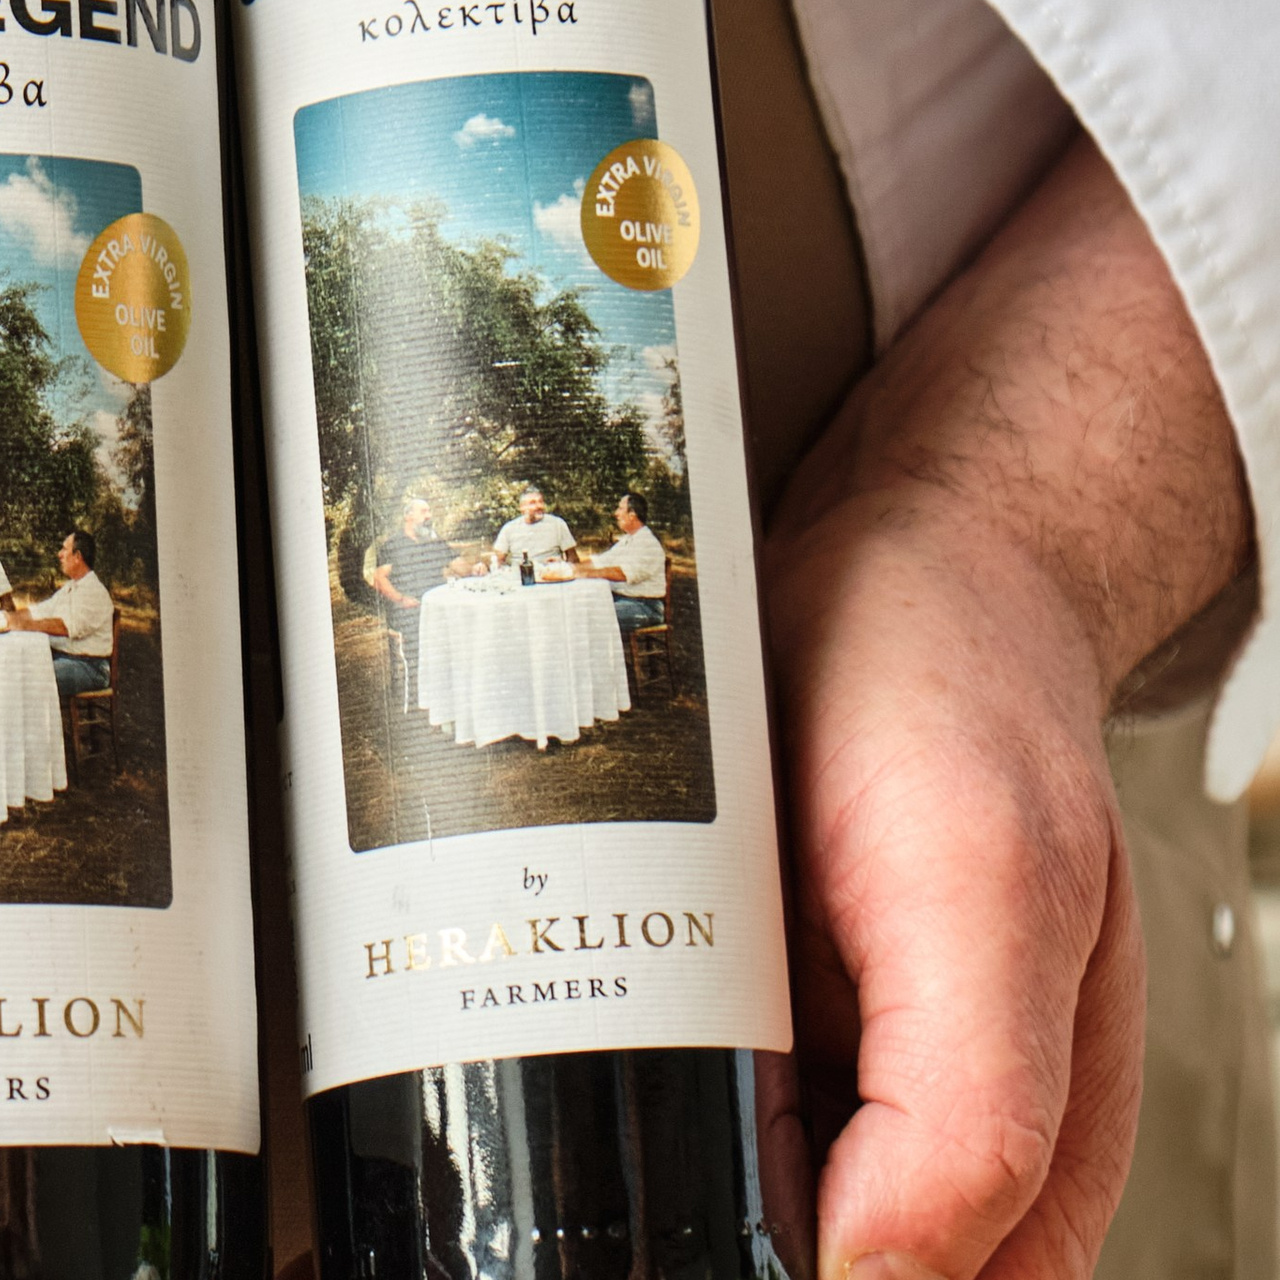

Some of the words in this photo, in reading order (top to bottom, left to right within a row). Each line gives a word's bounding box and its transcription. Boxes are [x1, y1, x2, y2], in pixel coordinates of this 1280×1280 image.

[596, 156, 641, 217] EXTRA
[643, 155, 692, 228] VIRGIN
[620, 220, 673, 245] OLIVE
[92, 233, 135, 299] EXTRA
[139, 233, 184, 310] VIRGIN
[636, 247, 668, 269] OIL
[115, 304, 167, 332] OLIVE
[130, 335, 160, 359] OIL
[523, 867, 549, 895] by
[364, 912, 716, 979] HERAKLION
[460, 976, 629, 1011] FARMERS
